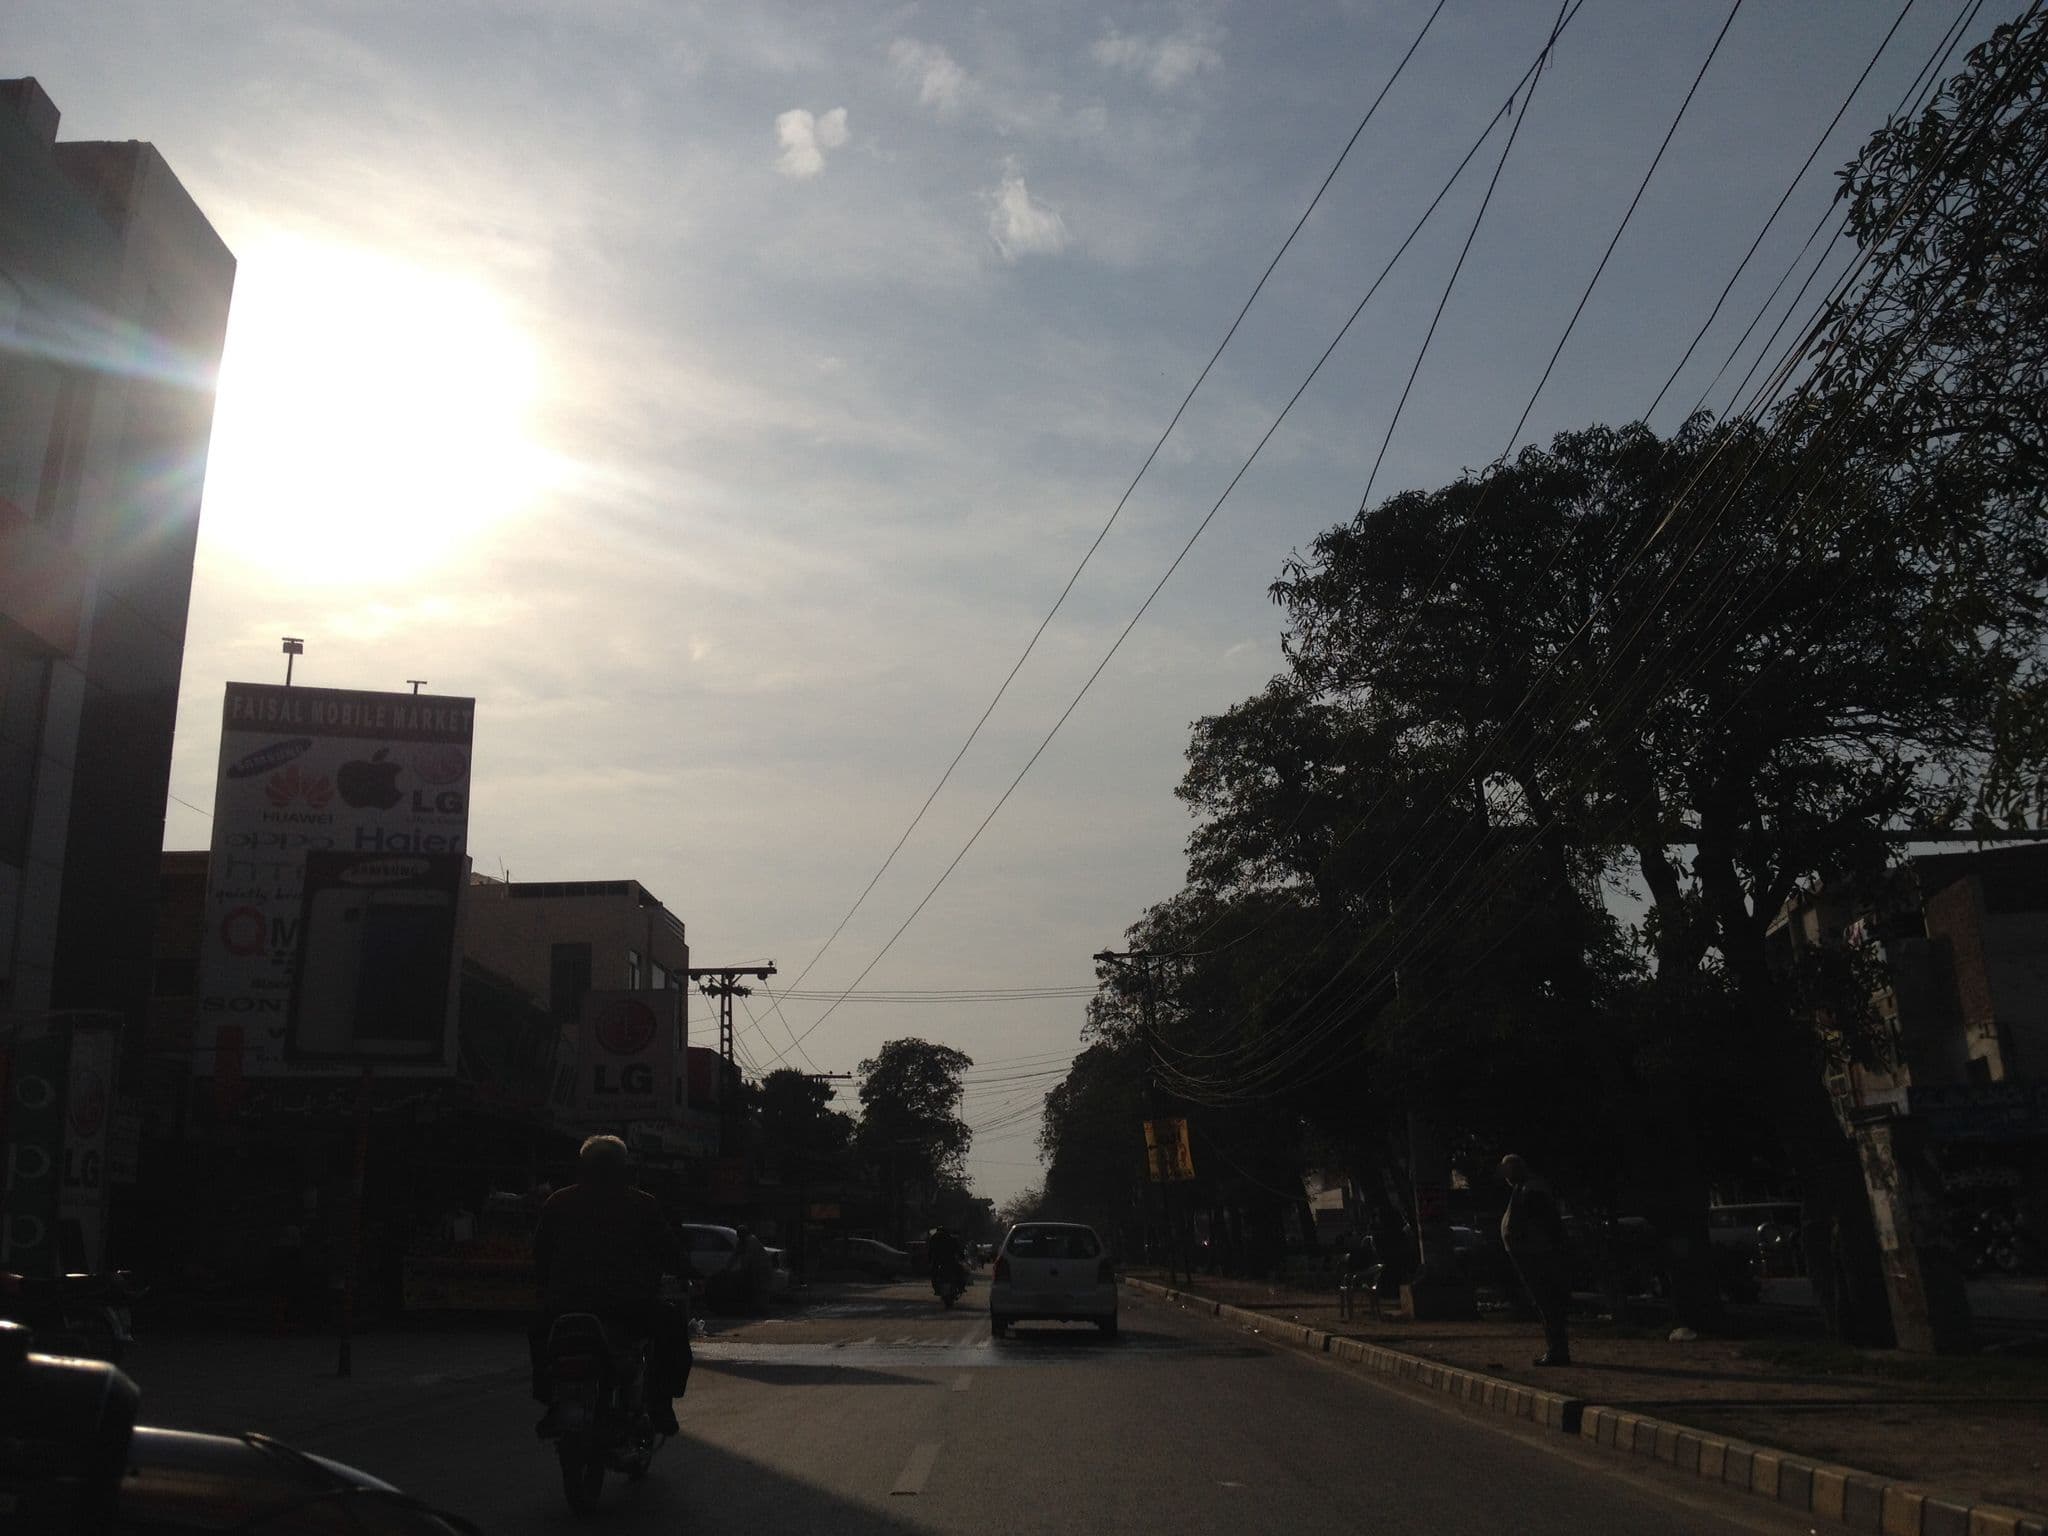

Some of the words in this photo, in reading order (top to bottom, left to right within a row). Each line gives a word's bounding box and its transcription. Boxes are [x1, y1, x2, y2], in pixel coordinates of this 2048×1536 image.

[232, 696, 303, 723] FAISAL
[311, 700, 386, 728] MOBILE
[393, 706, 472, 733] MARKET
[411, 789, 464, 815] LG
[262, 812, 334, 825] HUAWEI
[355, 826, 461, 853] Haier
[593, 1063, 655, 1095] LG
[63, 1148, 100, 1188] LG
